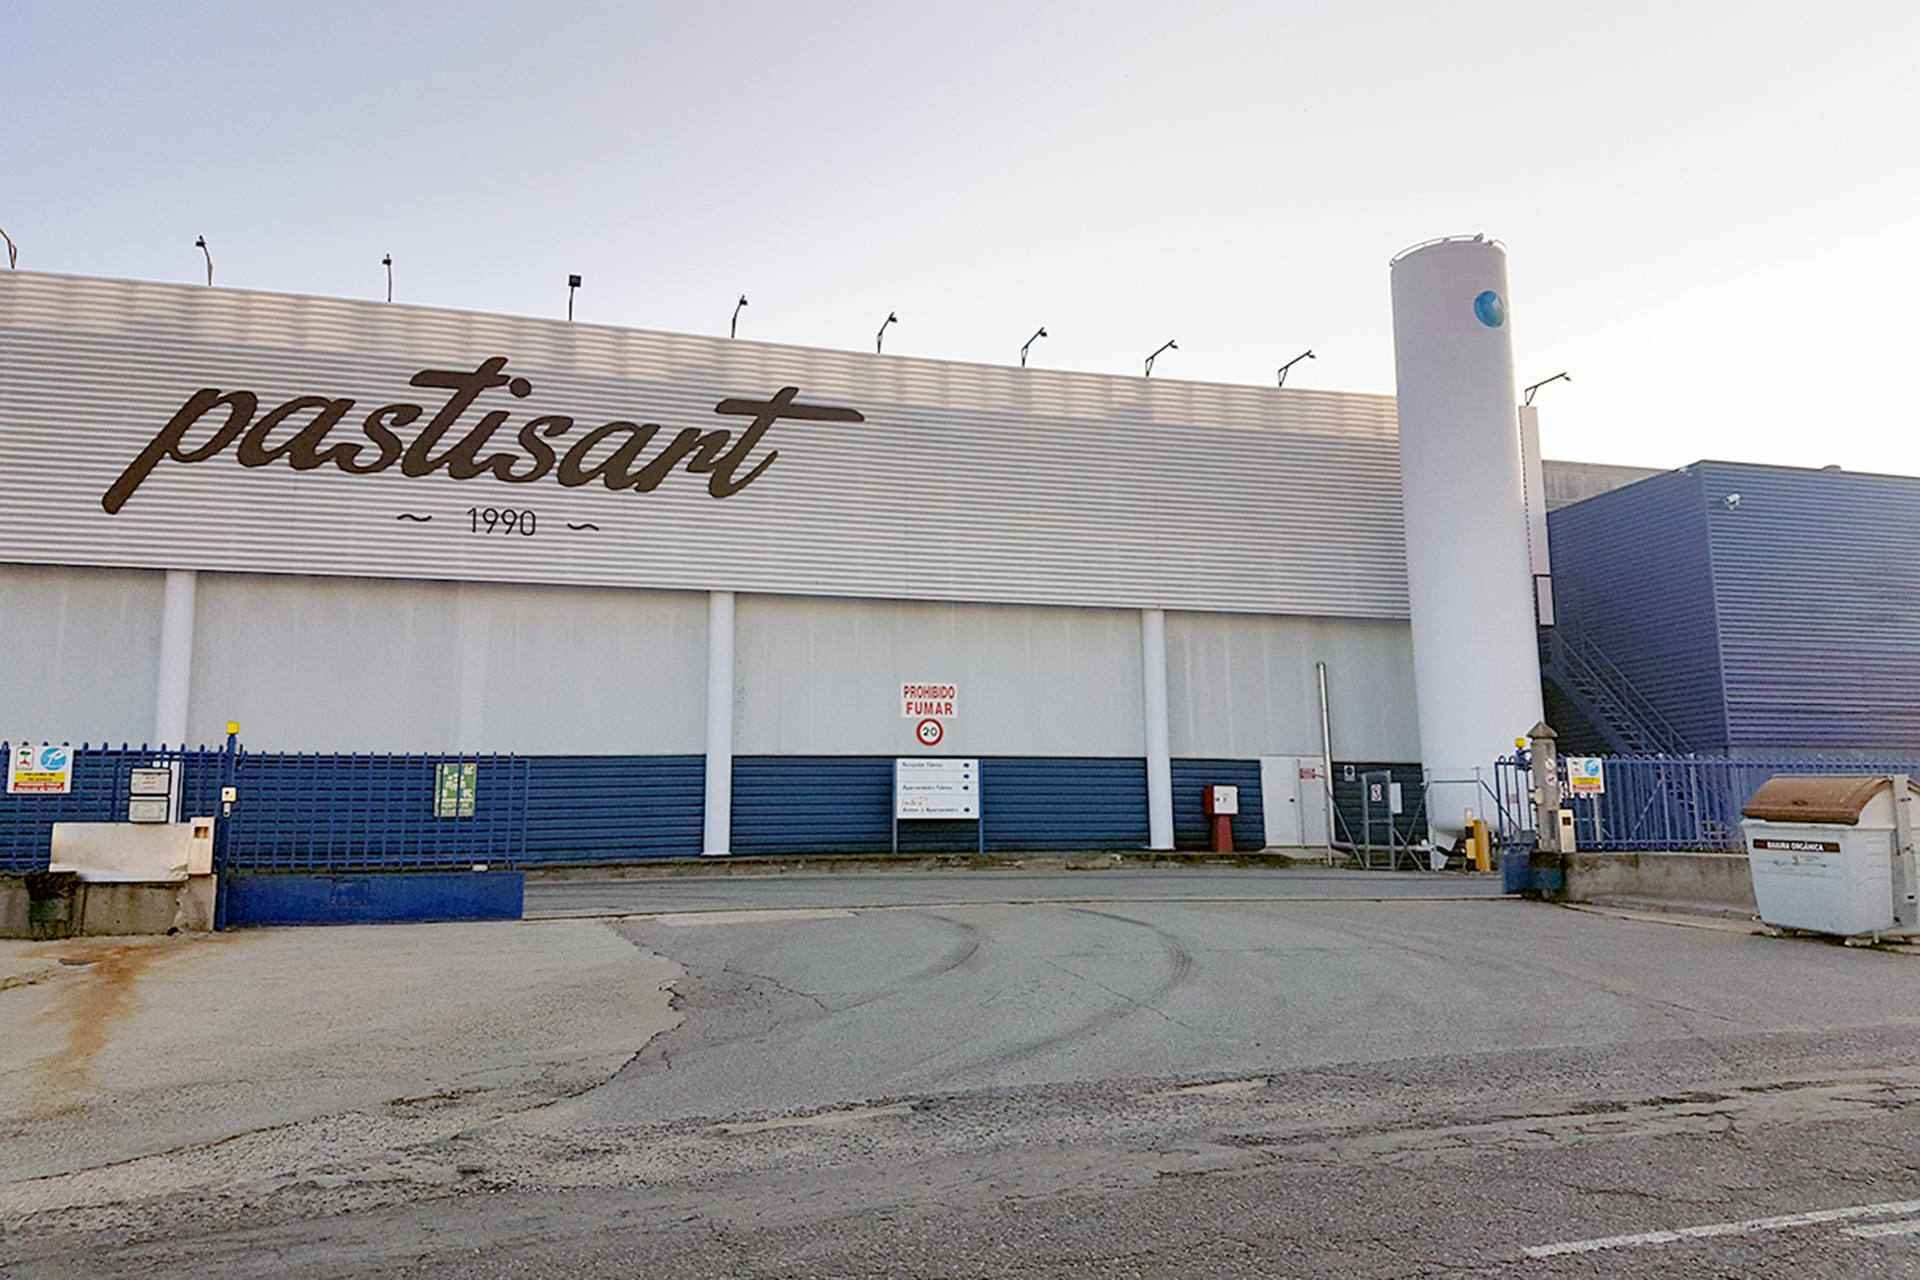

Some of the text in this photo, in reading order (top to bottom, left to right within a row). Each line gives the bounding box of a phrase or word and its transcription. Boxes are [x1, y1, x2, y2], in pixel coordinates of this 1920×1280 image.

[102, 356, 865, 515] pastisart
[467, 507, 536, 536] 1990
[903, 685, 955, 699] PROHIBIDO
[906, 701, 953, 715] FUMAR
[922, 726, 938, 737] 20
